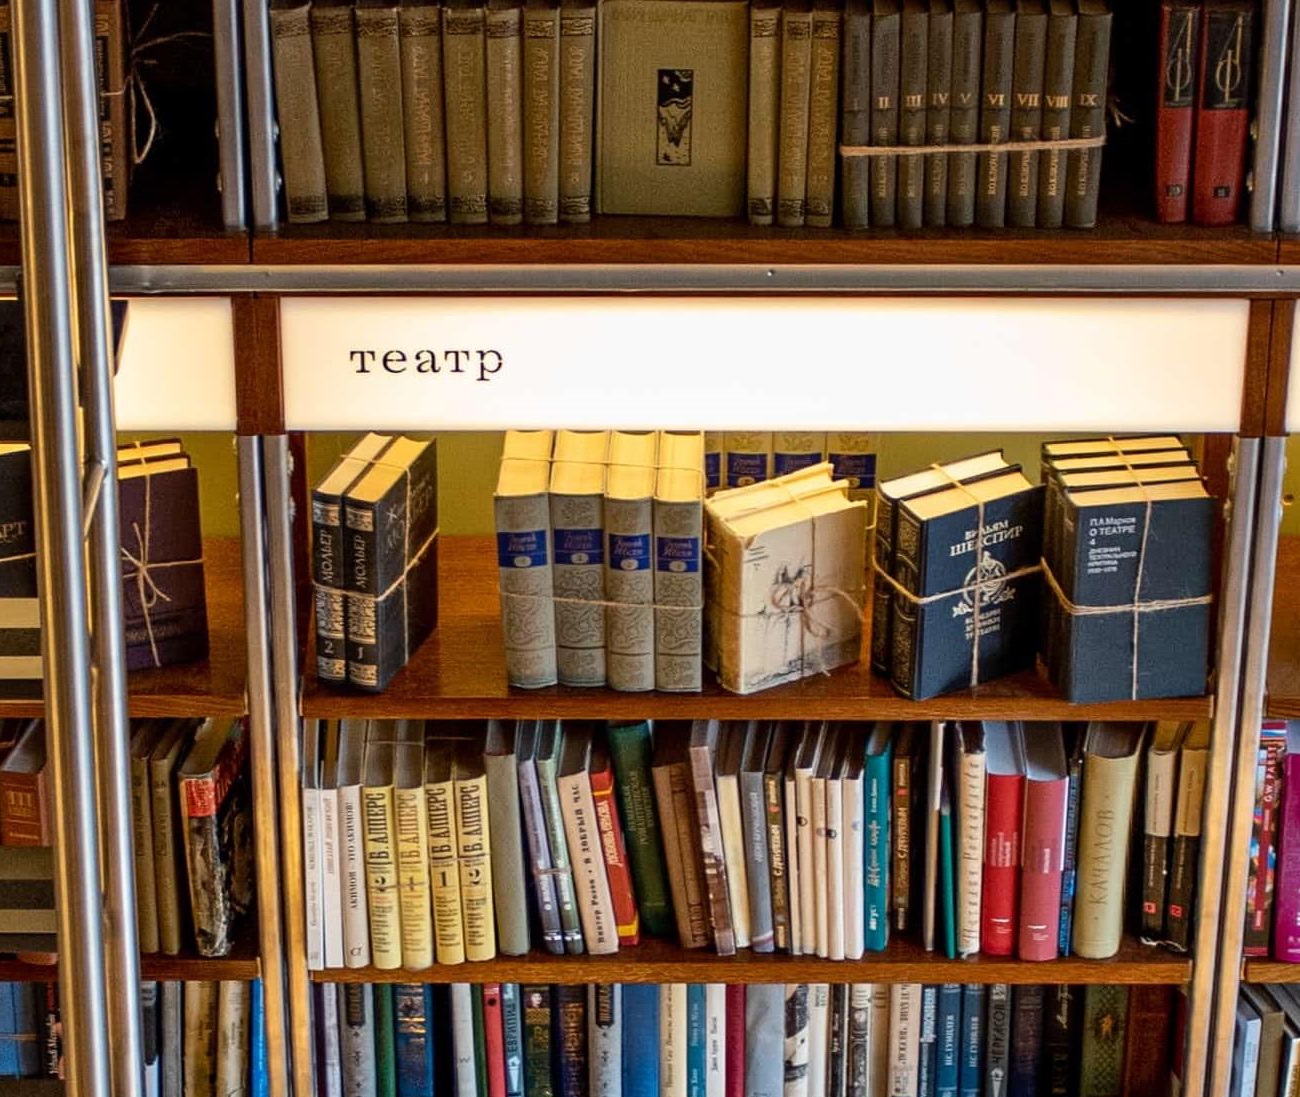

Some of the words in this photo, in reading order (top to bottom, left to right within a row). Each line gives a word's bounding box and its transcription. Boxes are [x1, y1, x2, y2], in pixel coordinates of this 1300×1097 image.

[878, 96, 890, 109] II
[905, 95, 922, 107] III
[932, 93, 948, 105] IV
[987, 94, 1003, 106] VI
[1017, 94, 1039, 106] VII
[1046, 95, 1068, 108] VIII
[1079, 94, 1097, 106] IX
[349, 351, 503, 382] театр
[1090, 529, 1097, 538] О
[1099, 525, 1136, 536] ТЕАТРЕ
[318, 529, 334, 584] МОЛЬЕР
[354, 535, 367, 588] МОЛЬЕР
[570, 784, 581, 803] ЧАС
[574, 807, 592, 854] ДОБРЫЙ
[1088, 808, 1114, 905] КАЧАЛОВ
[586, 879, 599, 906] Розов
[591, 908, 607, 943] Виктор
[505, 1003, 517, 1051] ЕВРИПИД
[990, 1004, 1005, 1062] ЧЕРКАСОВ
